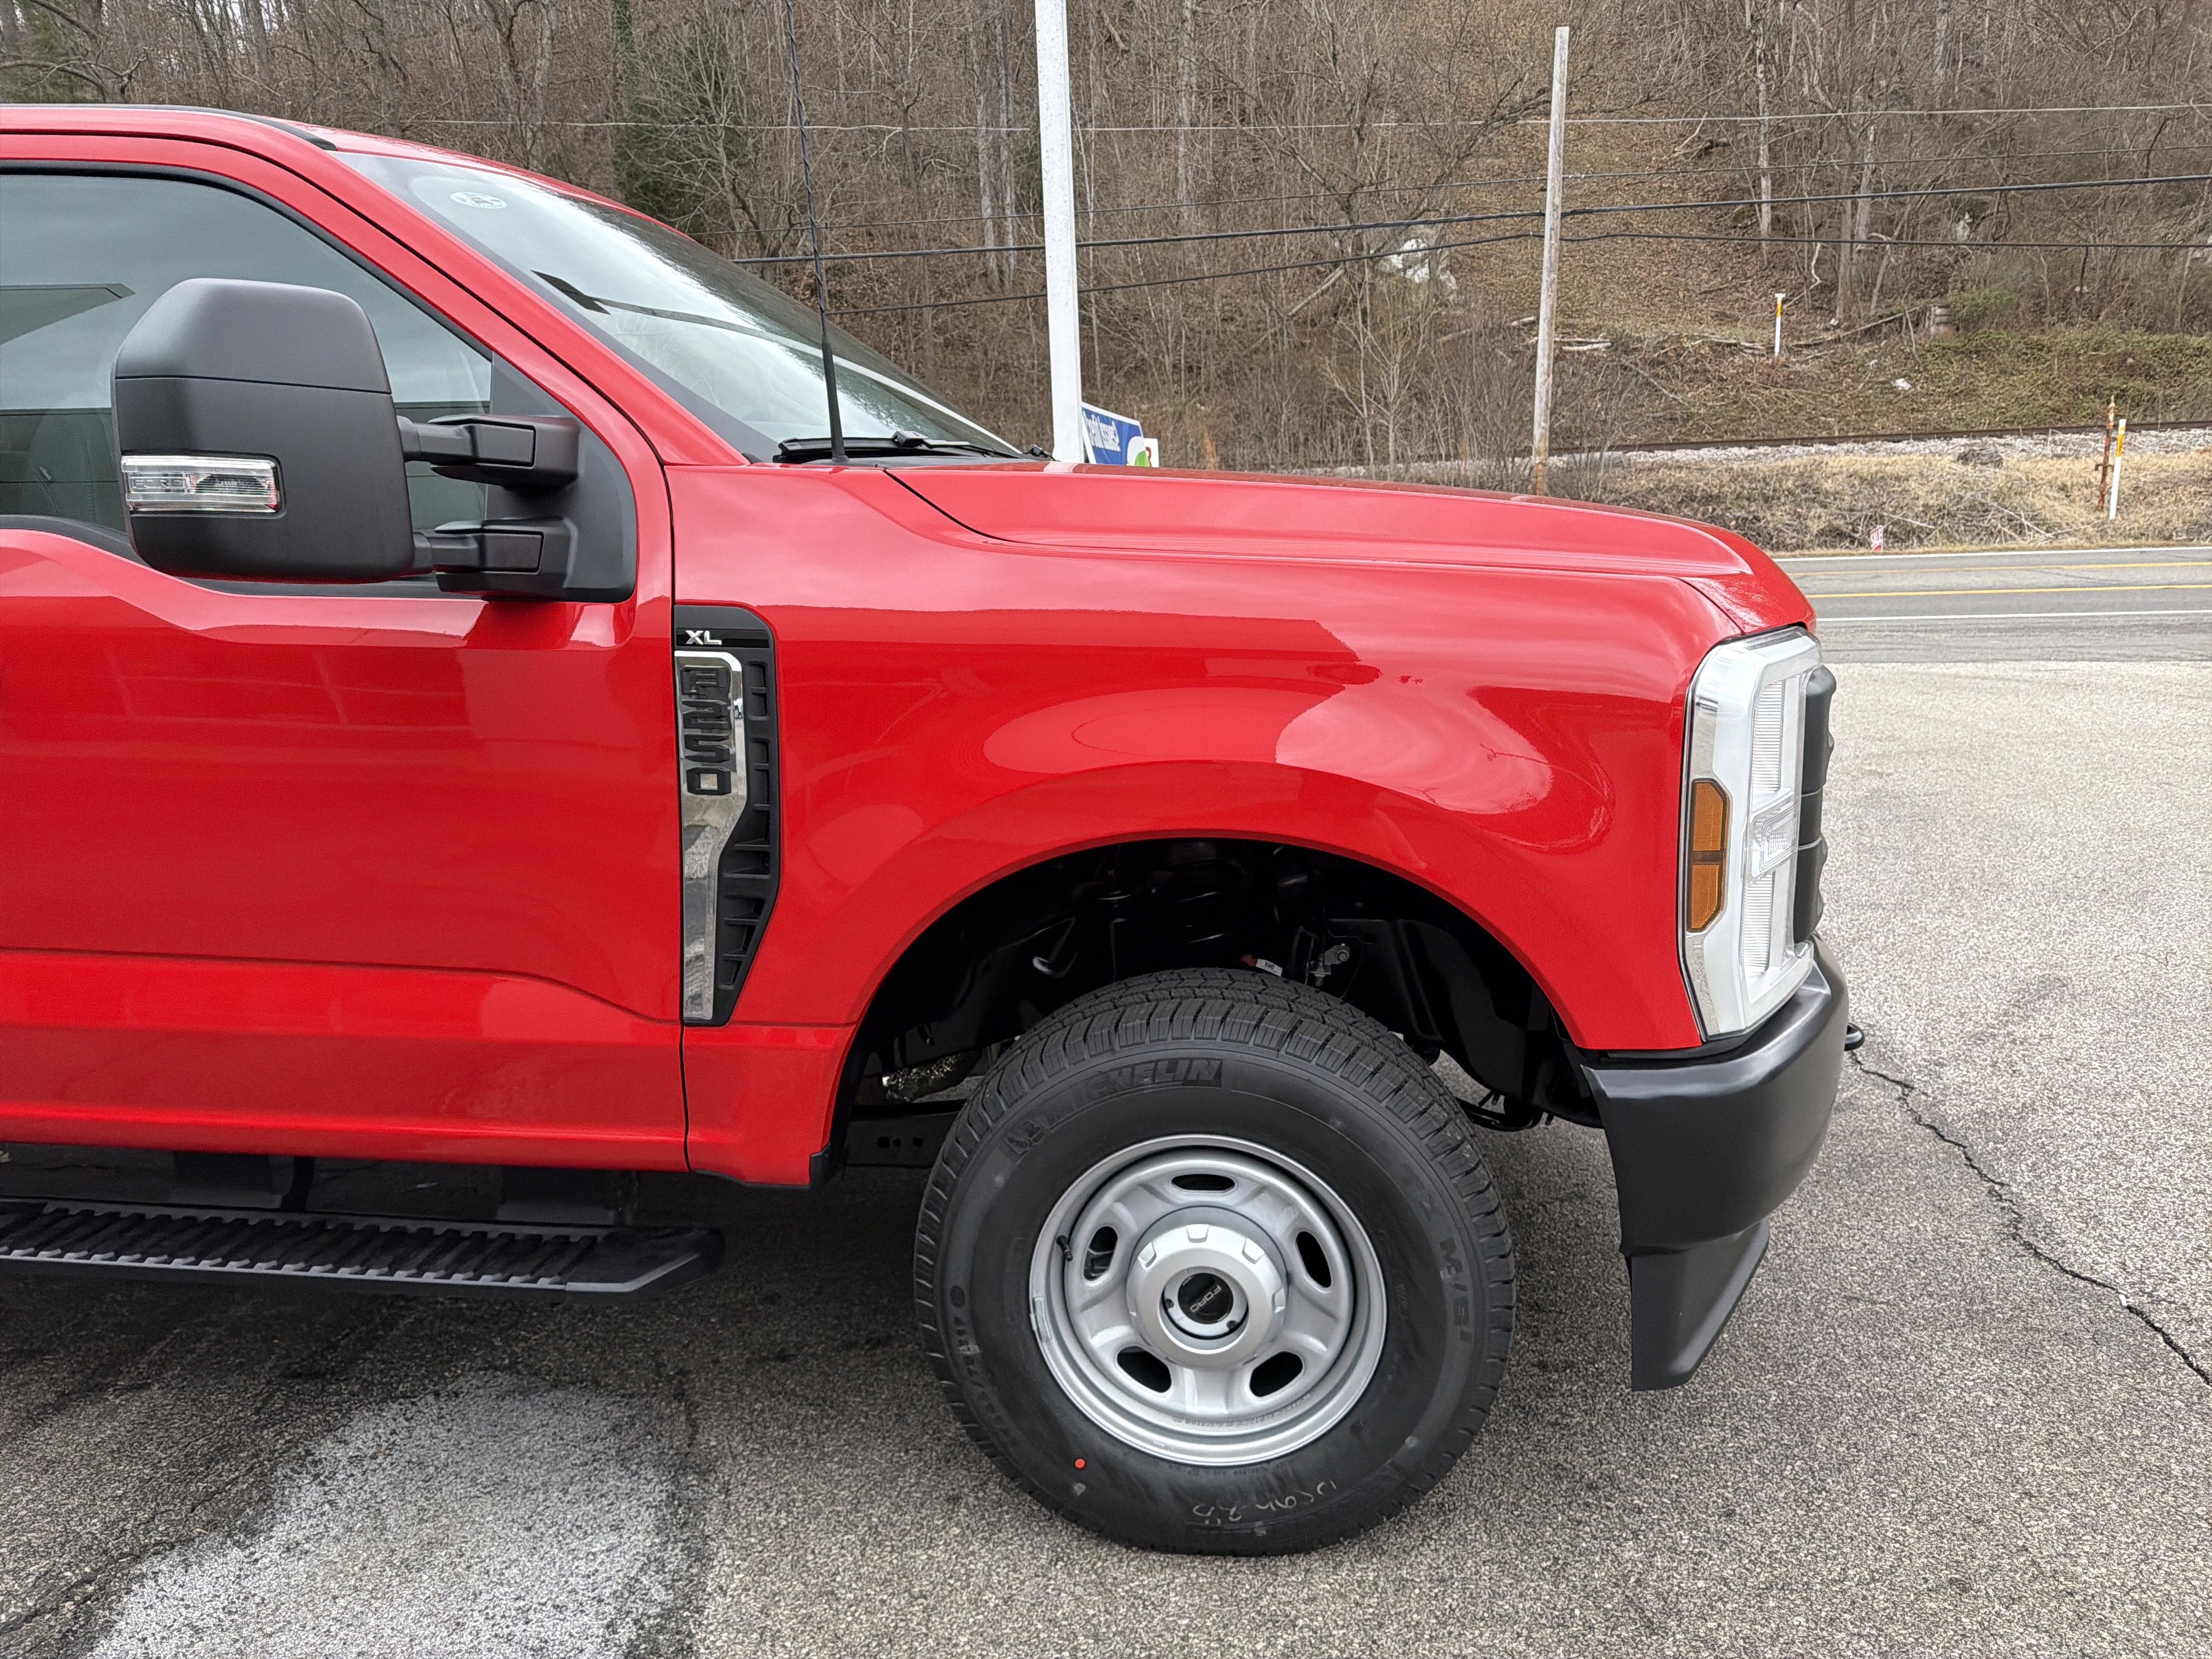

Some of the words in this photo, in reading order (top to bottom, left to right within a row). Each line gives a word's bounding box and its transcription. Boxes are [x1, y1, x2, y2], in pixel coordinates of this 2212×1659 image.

[685, 630, 722, 645] XL
[1044, 1058, 1223, 1125] CHELIN
[1189, 1284, 1222, 1313] FORD
